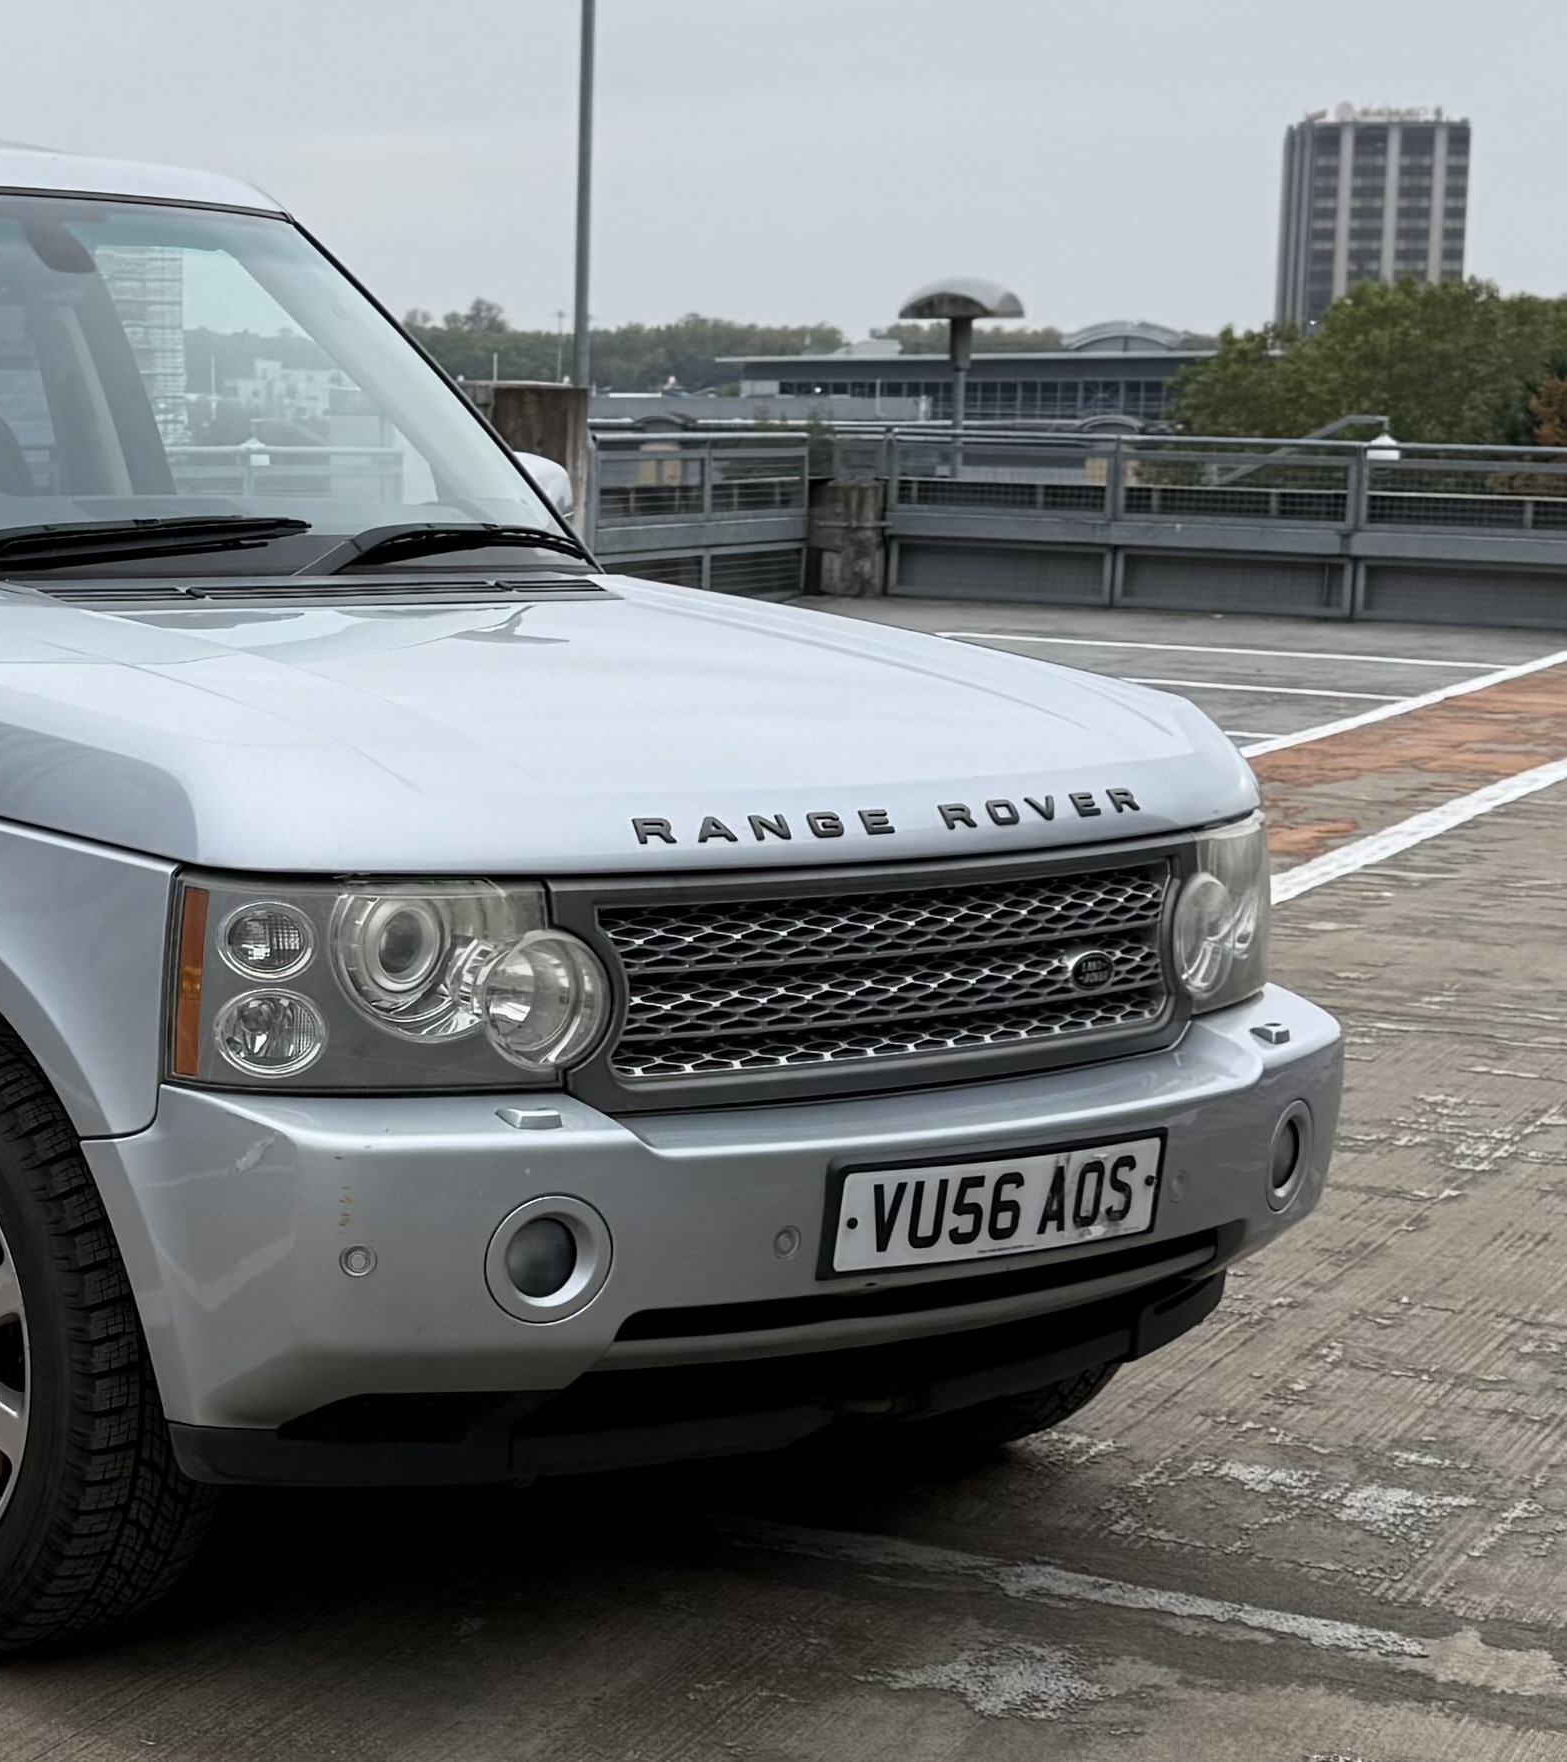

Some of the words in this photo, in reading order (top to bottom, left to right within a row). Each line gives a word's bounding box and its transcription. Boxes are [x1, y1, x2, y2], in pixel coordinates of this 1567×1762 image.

[632, 809, 895, 845] RANGE
[937, 787, 1141, 831] ROVER
[873, 1172, 1025, 1253] VU56
[1036, 1154, 1137, 1235] AOS
